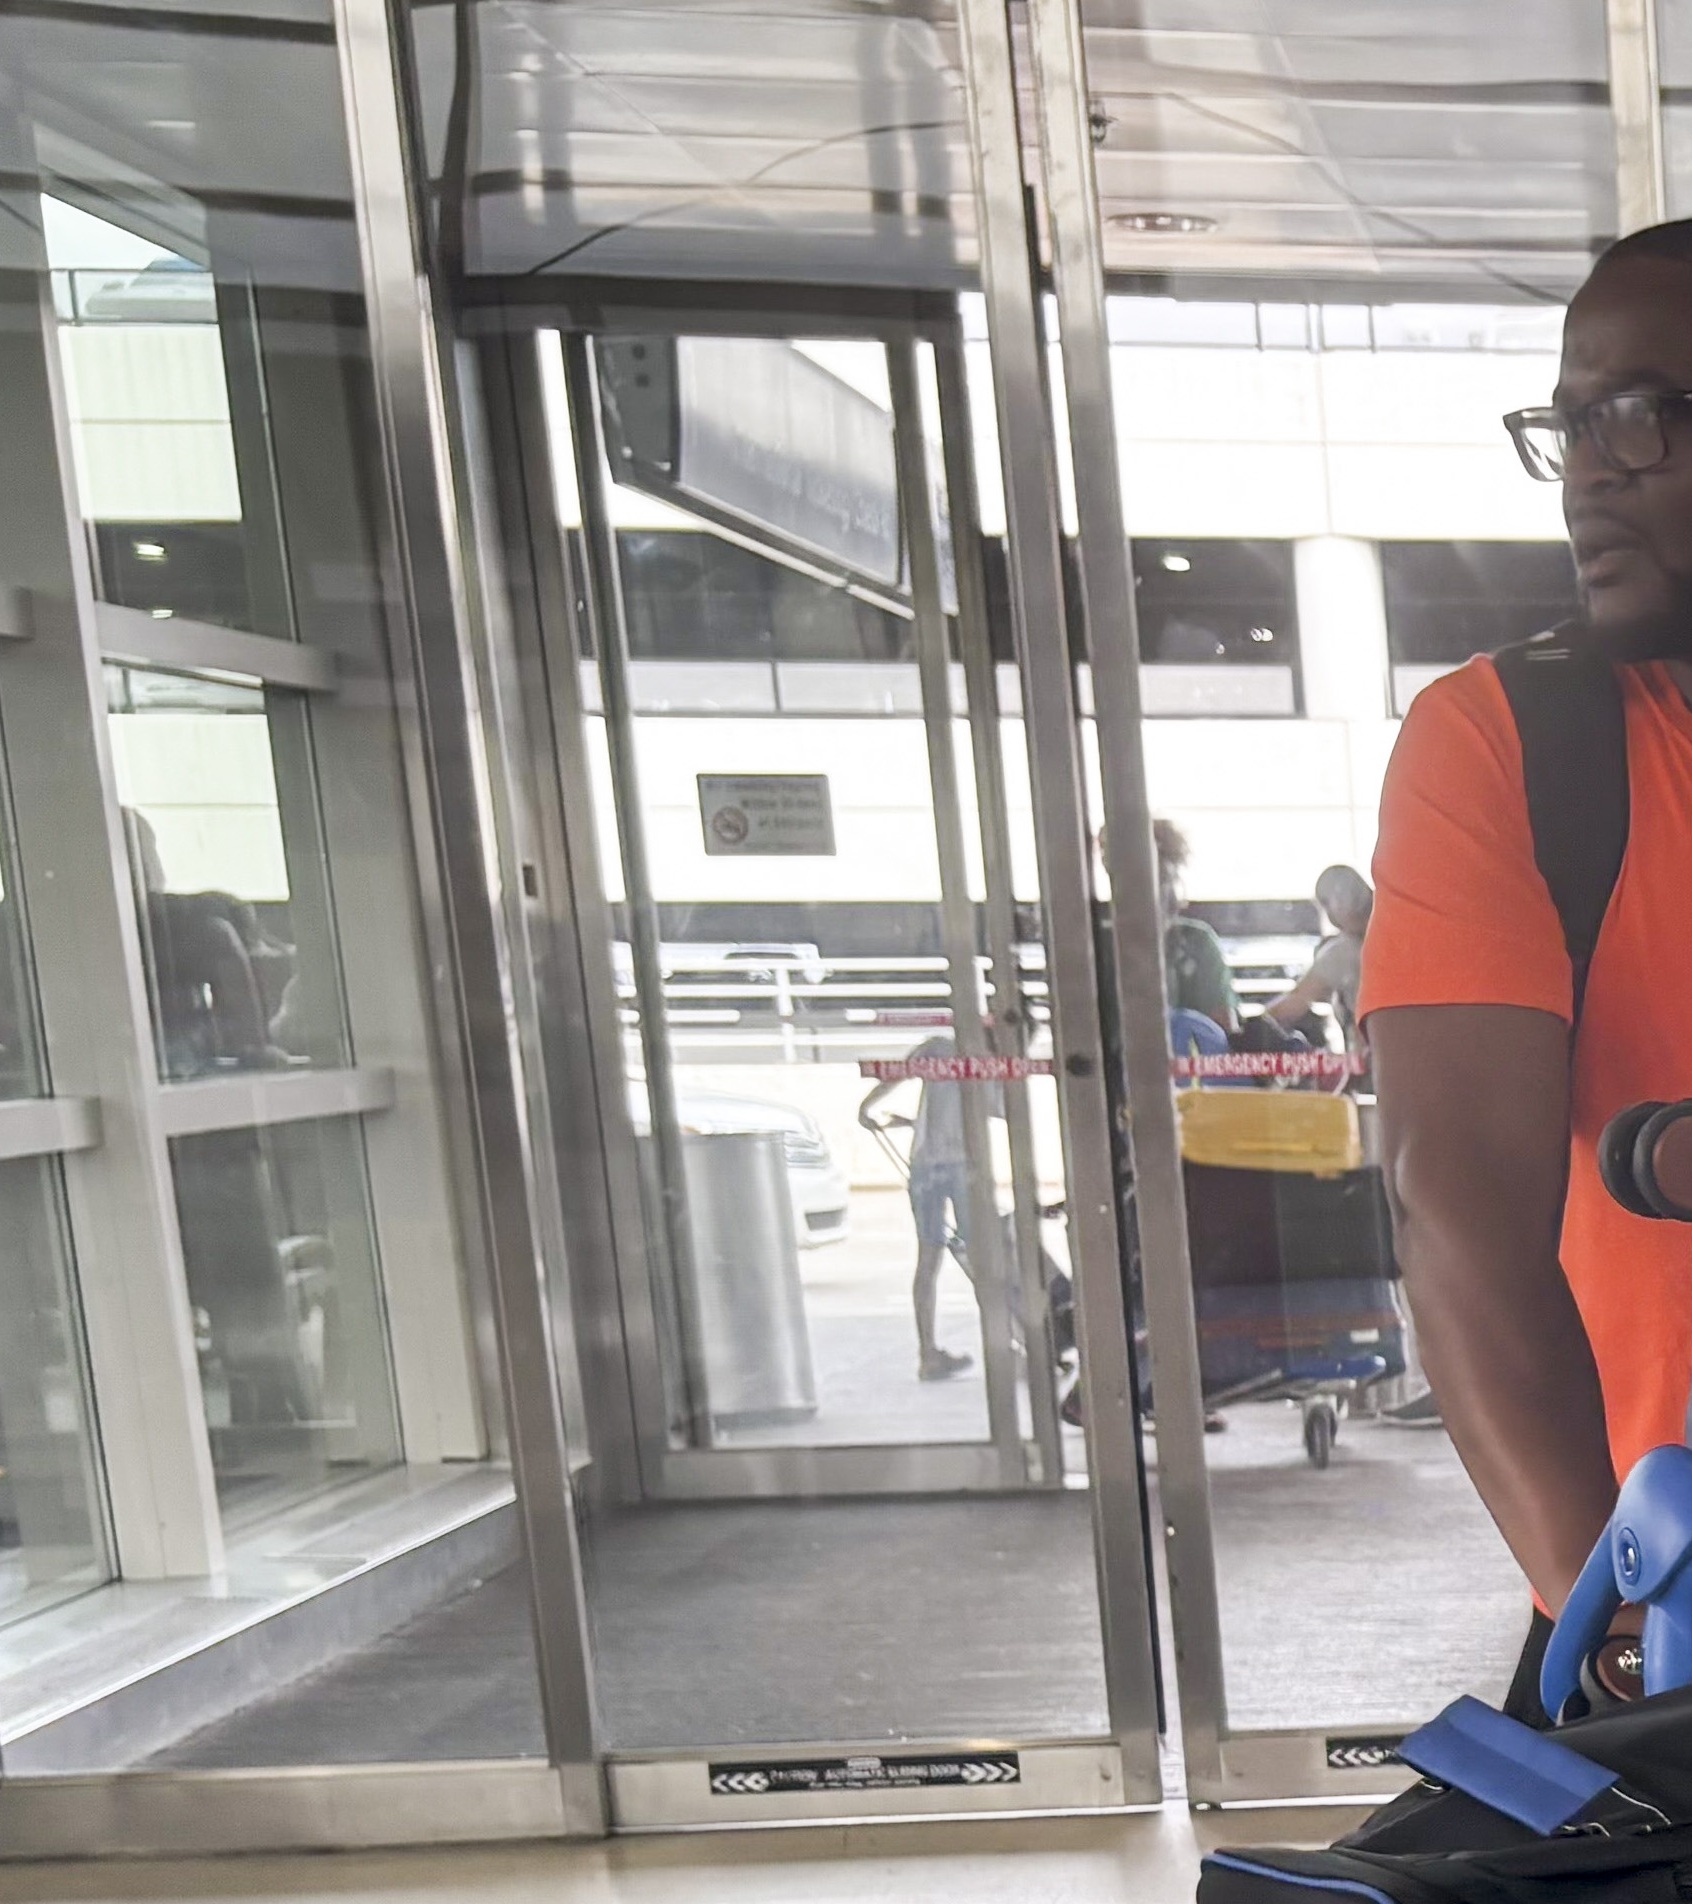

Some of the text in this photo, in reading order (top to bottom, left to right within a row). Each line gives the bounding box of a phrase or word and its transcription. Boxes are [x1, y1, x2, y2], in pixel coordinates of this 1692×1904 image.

[879, 1056, 965, 1081] EMERGENCY
[968, 1056, 1008, 1079] PUSH
[1194, 1052, 1278, 1075] EMERGENCY
[1282, 1052, 1319, 1075] PUSH
